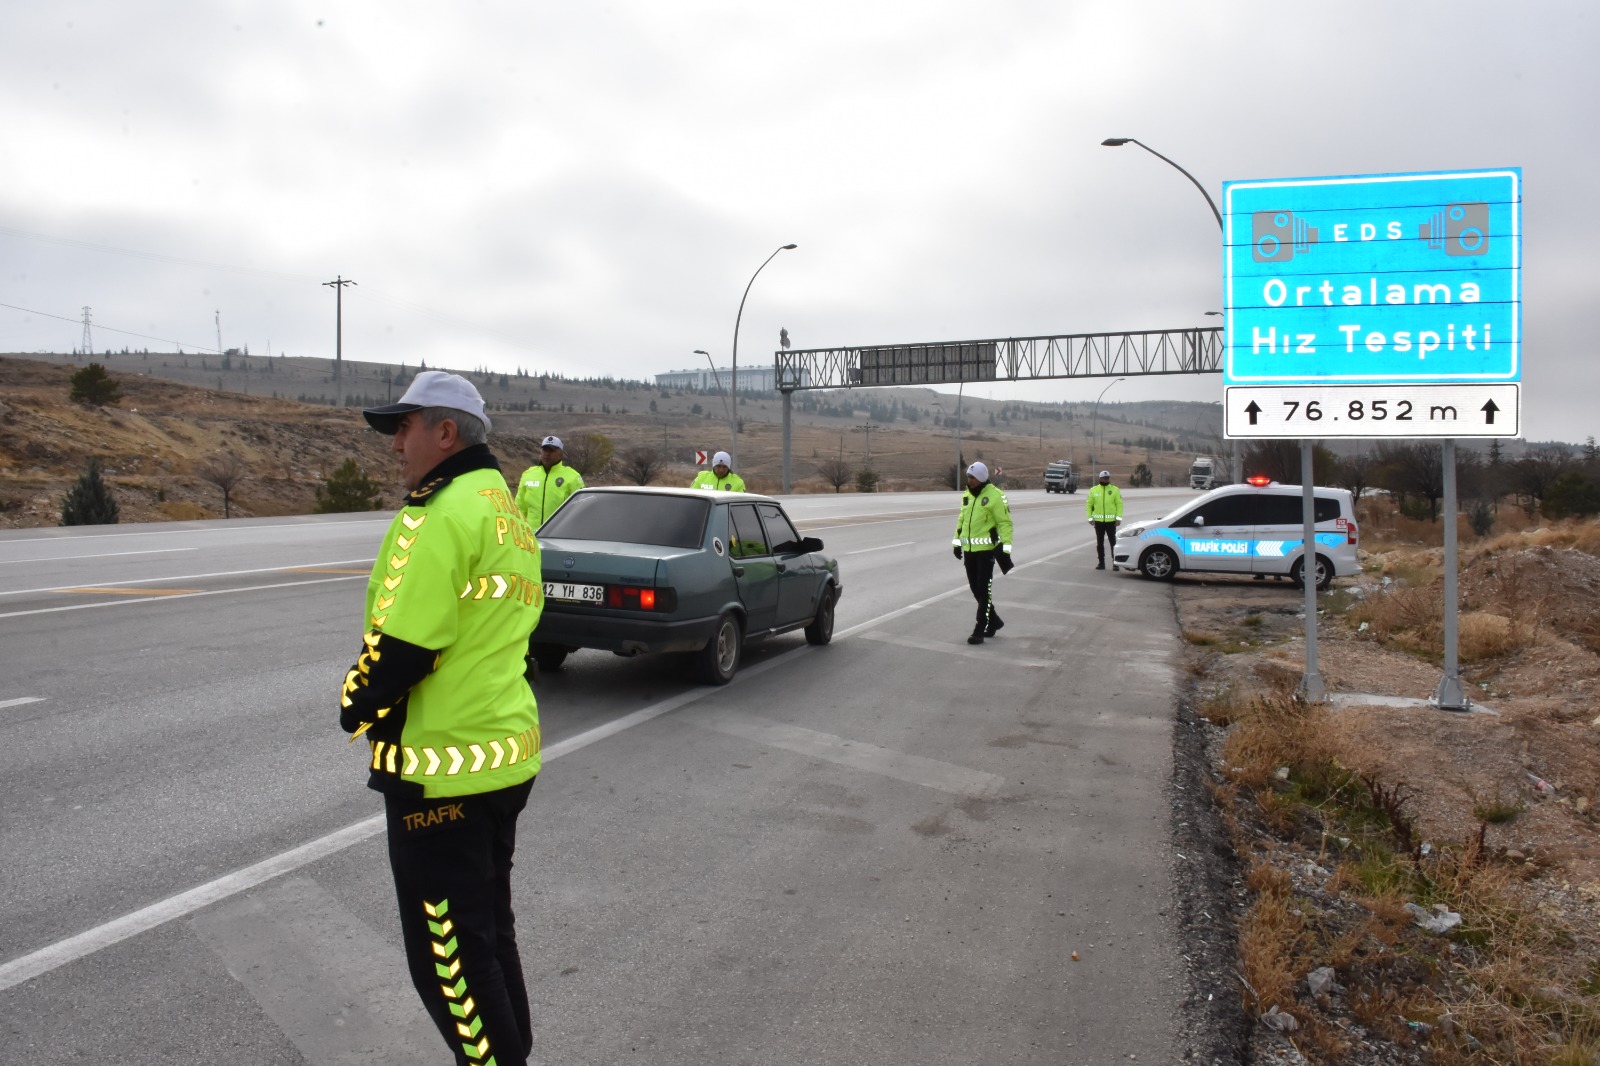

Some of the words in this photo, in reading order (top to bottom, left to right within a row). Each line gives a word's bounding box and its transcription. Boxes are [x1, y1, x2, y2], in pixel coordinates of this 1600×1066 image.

[1333, 221, 1403, 243] EDS
[1263, 277, 1481, 307] Ortalama
[1252, 326, 1317, 355] Hız
[1338, 323, 1491, 360] Tespiti
[1283, 400, 1413, 422] 76.852
[1429, 404, 1458, 421] m
[563, 585, 575, 598] YH
[582, 586, 603, 600] 836
[402, 802, 466, 832] TRAFİK
